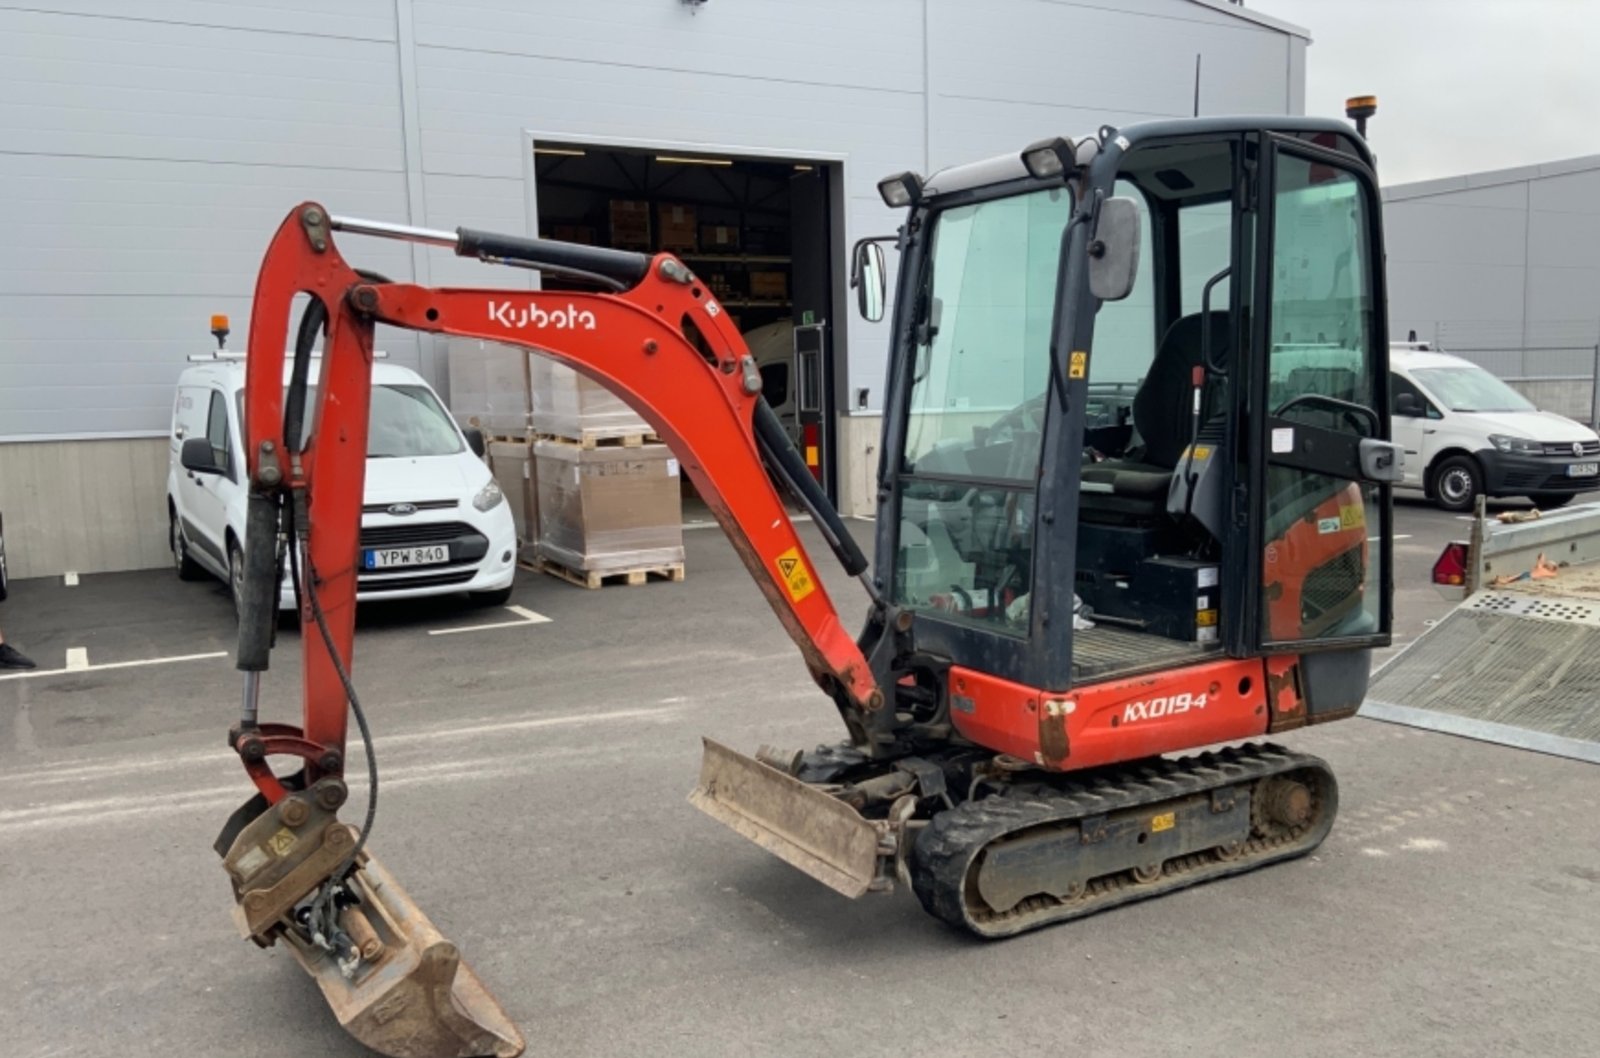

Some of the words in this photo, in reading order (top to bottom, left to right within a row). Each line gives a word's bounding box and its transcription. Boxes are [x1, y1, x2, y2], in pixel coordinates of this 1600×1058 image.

[488, 301, 596, 330] Kubota
[380, 550, 410, 566] YPW
[415, 547, 444, 563] 840
[1123, 693, 1207, 723] KX019-4
